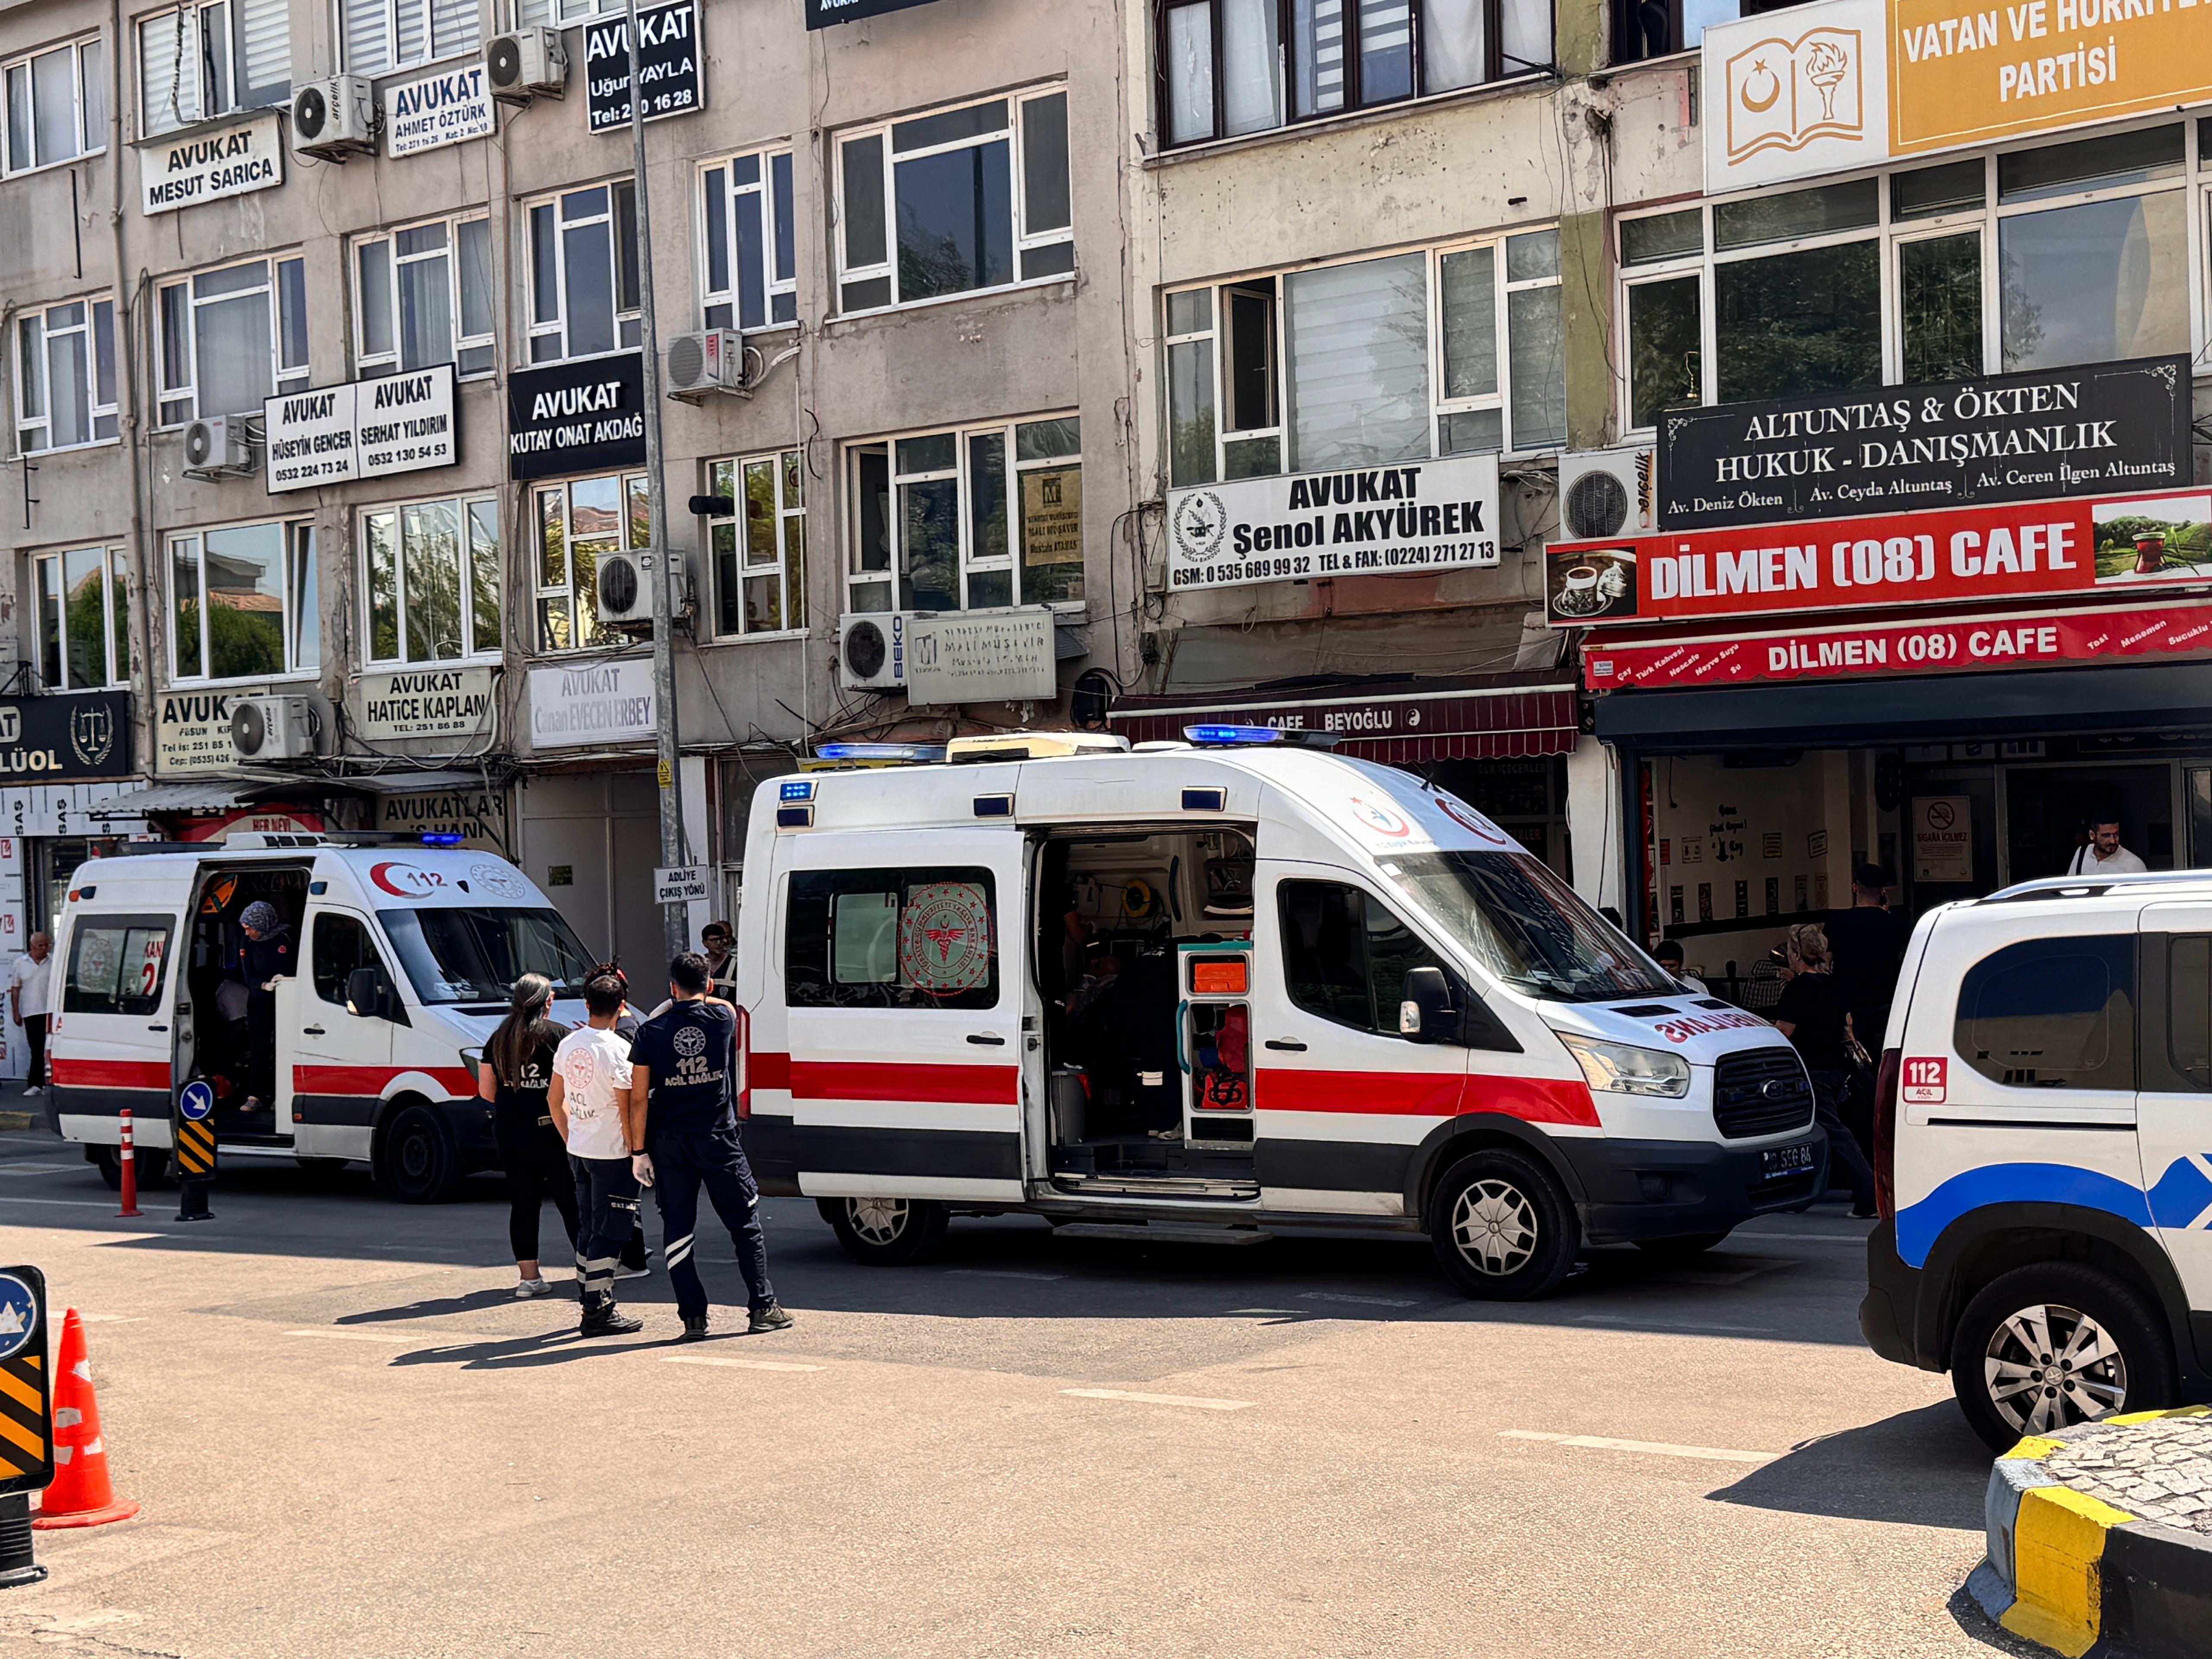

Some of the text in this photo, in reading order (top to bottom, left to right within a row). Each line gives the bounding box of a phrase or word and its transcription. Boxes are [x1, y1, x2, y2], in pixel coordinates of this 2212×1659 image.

[588, 6, 692, 62] AVUKAT
[1903, 10, 1997, 63] VATAN
[2007, 0, 2047, 41] VE
[591, 57, 693, 97] Uğur YAYLA
[2000, 36, 2116, 102] PARTİSİ
[396, 69, 481, 118] AVUKAT
[592, 89, 692, 125] Tel: 20 16 28
[395, 103, 486, 139] AHMET ÖZTÜRK
[168, 131, 252, 172] AVUKAT
[149, 158, 273, 205] MESUT SARICA
[375, 375, 432, 409] AVUKAT
[532, 381, 621, 420] AVUKAT
[282, 393, 336, 425] AVUKAT
[1744, 382, 2081, 442] ALTUNTAŞ & ÖKTEN
[272, 431, 352, 461] HÜSEYİN GENCER
[361, 414, 447, 446] SERHAT YILDIRIM
[510, 412, 643, 454] KUTAY ONAT AKDAĞ
[368, 443, 447, 466] 0532 130 54 53
[1715, 447, 1836, 483] HUKUK
[1861, 420, 2118, 469] DANIŞMANLIK
[276, 460, 348, 481] 0532 224 73 24
[1977, 460, 2175, 488] Av. Ceren İlgen Altuntaş
[1288, 467, 1422, 510] AVUKAT
[1668, 490, 1783, 515] Av. Deniz Ökten
[1810, 478, 1952, 502] Av. Ceyda Altuntaş
[1233, 500, 1484, 560] Şenol AKYÜREK
[1173, 567, 1204, 585] GSM:
[1207, 566, 1214, 582] 0
[1217, 563, 1242, 581] 535
[1274, 558, 1290, 575] 99
[1294, 556, 1310, 574] 32
[1319, 553, 1339, 571] TEL
[1343, 554, 1352, 569] &
[1356, 551, 1382, 569] FAX:
[1385, 545, 1430, 566] (0224)
[1433, 543, 1456, 563] 271
[1459, 542, 1477, 561] 27
[1479, 541, 1494, 559] 13
[1650, 521, 2077, 601] DİLMEN (08) CAFE
[893, 616, 903, 679] BEKO
[1769, 626, 2058, 671] DİLMEN (08) CAFE
[2087, 632, 2110, 650] Tost
[390, 673, 463, 694] AVUKAT
[561, 668, 620, 697] AVUKAT
[162, 693, 264, 724] AVUK
[424, 694, 486, 720] KAPLAN
[1267, 708, 1392, 731] CAFE BEYOĞLU
[385, 795, 504, 821] AVUKATLAR
[407, 872, 448, 887] 112
[659, 882, 705, 900] ÇIKIŞ YÖNÜ
[668, 868, 697, 882] ADLİYE
[676, 1056, 709, 1075] 112
[1909, 1062, 1941, 1084] 112
